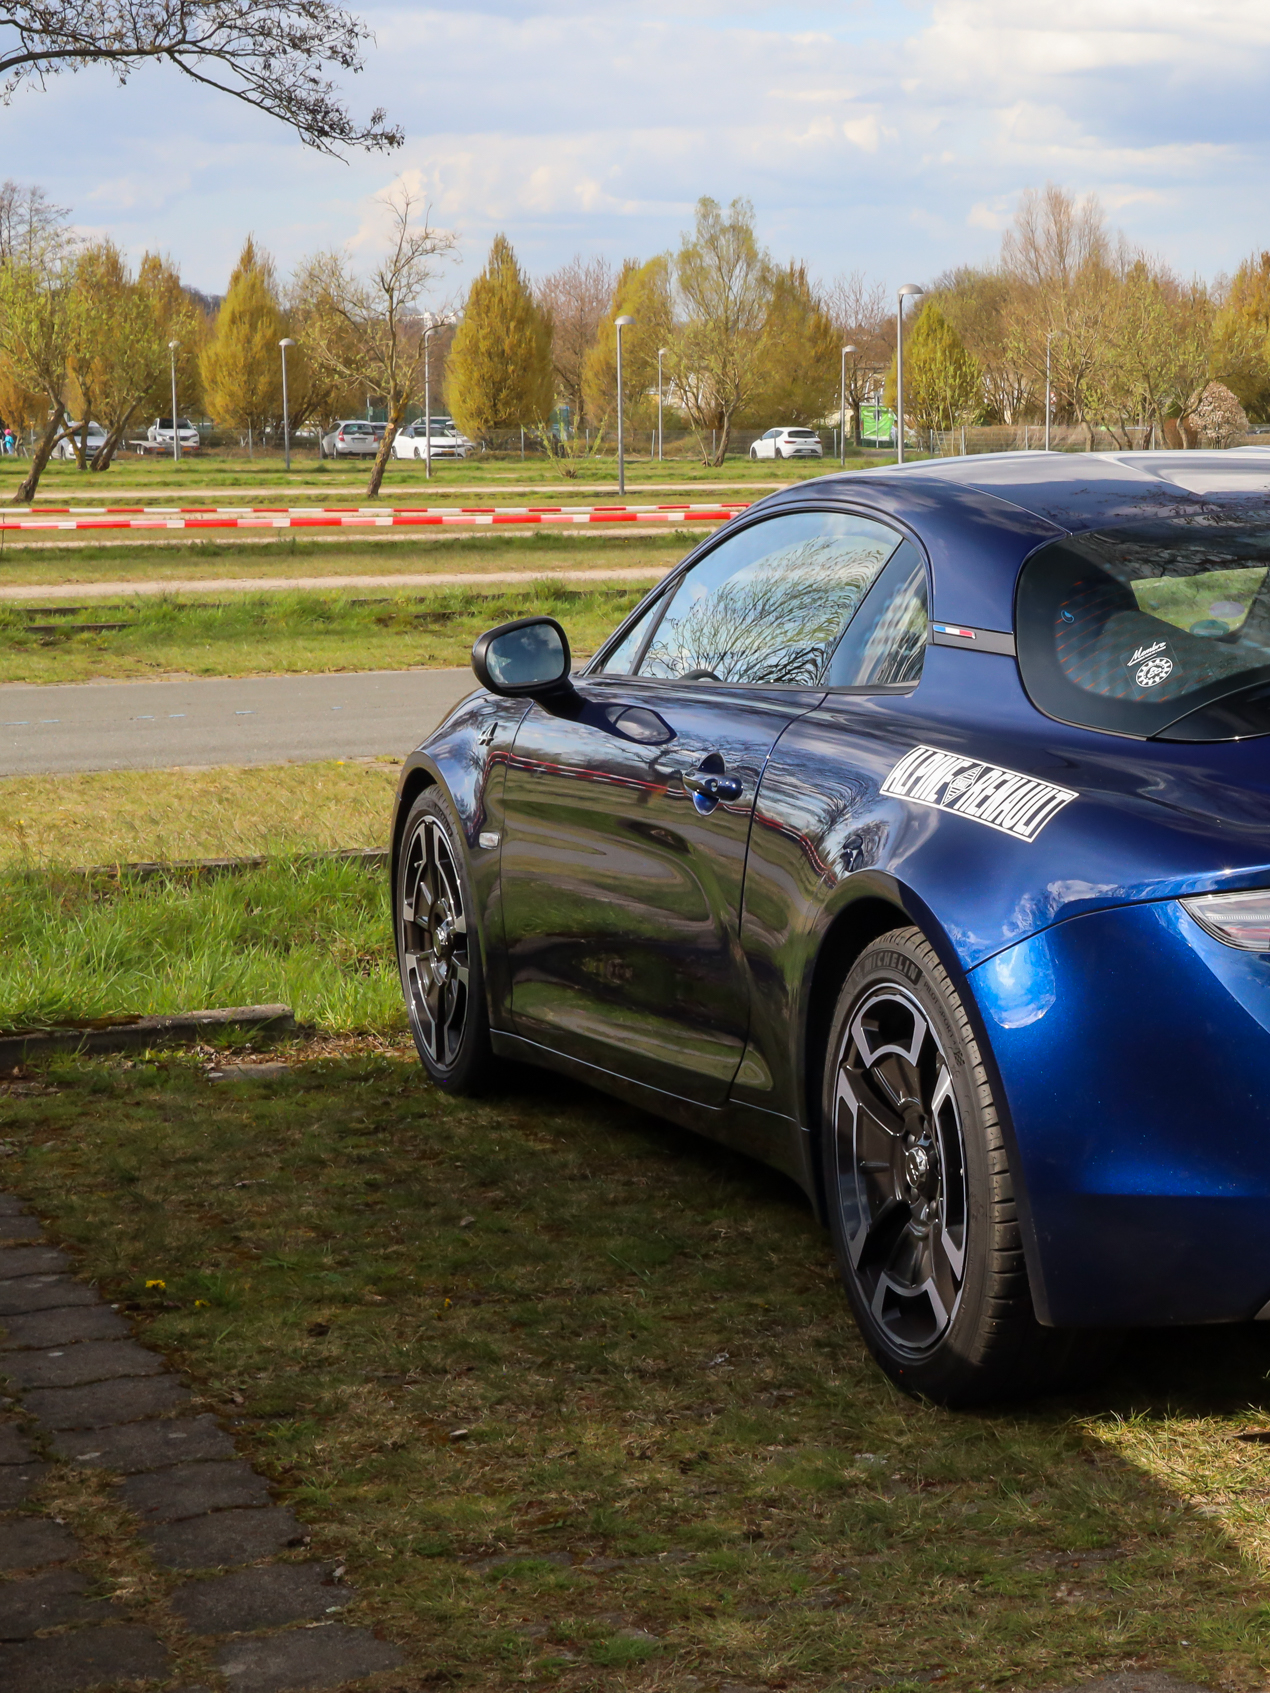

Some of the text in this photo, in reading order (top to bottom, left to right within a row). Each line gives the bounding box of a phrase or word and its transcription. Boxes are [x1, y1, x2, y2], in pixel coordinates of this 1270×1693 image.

[883, 748, 1073, 837] ALPINE RENAULT
[863, 952, 919, 982] MICHELIN
